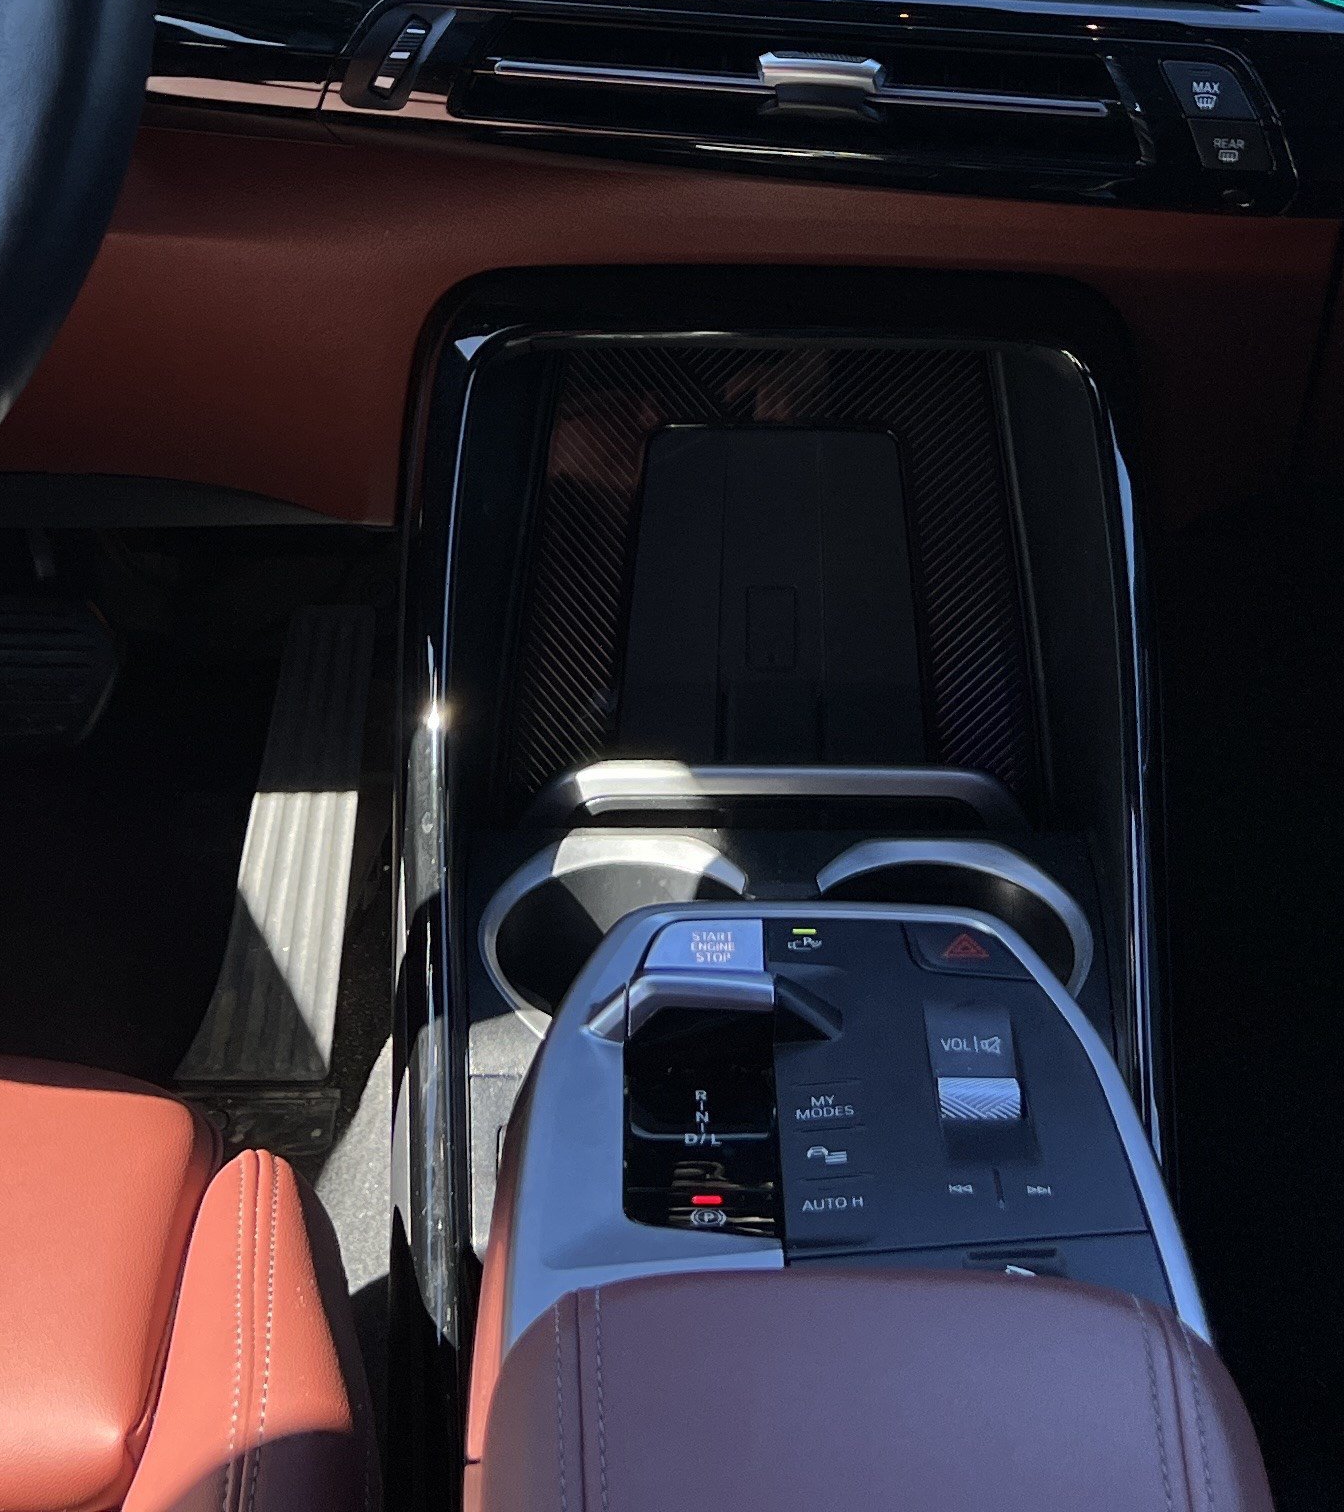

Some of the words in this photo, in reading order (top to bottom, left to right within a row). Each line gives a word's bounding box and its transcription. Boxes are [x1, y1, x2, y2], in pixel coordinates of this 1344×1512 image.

[1192, 81, 1220, 94] MAX
[1213, 138, 1245, 150] REAR
[691, 931, 733, 941] START
[690, 941, 736, 951] ENGINE
[695, 952, 732, 963] STOP
[940, 1037, 971, 1051] VOL
[695, 1090, 707, 1100] R
[810, 1094, 835, 1107] MY
[695, 1111, 709, 1123] N
[795, 1105, 854, 1120] MODES
[802, 1197, 848, 1212] AUTO
[852, 1196, 863, 1207] H
